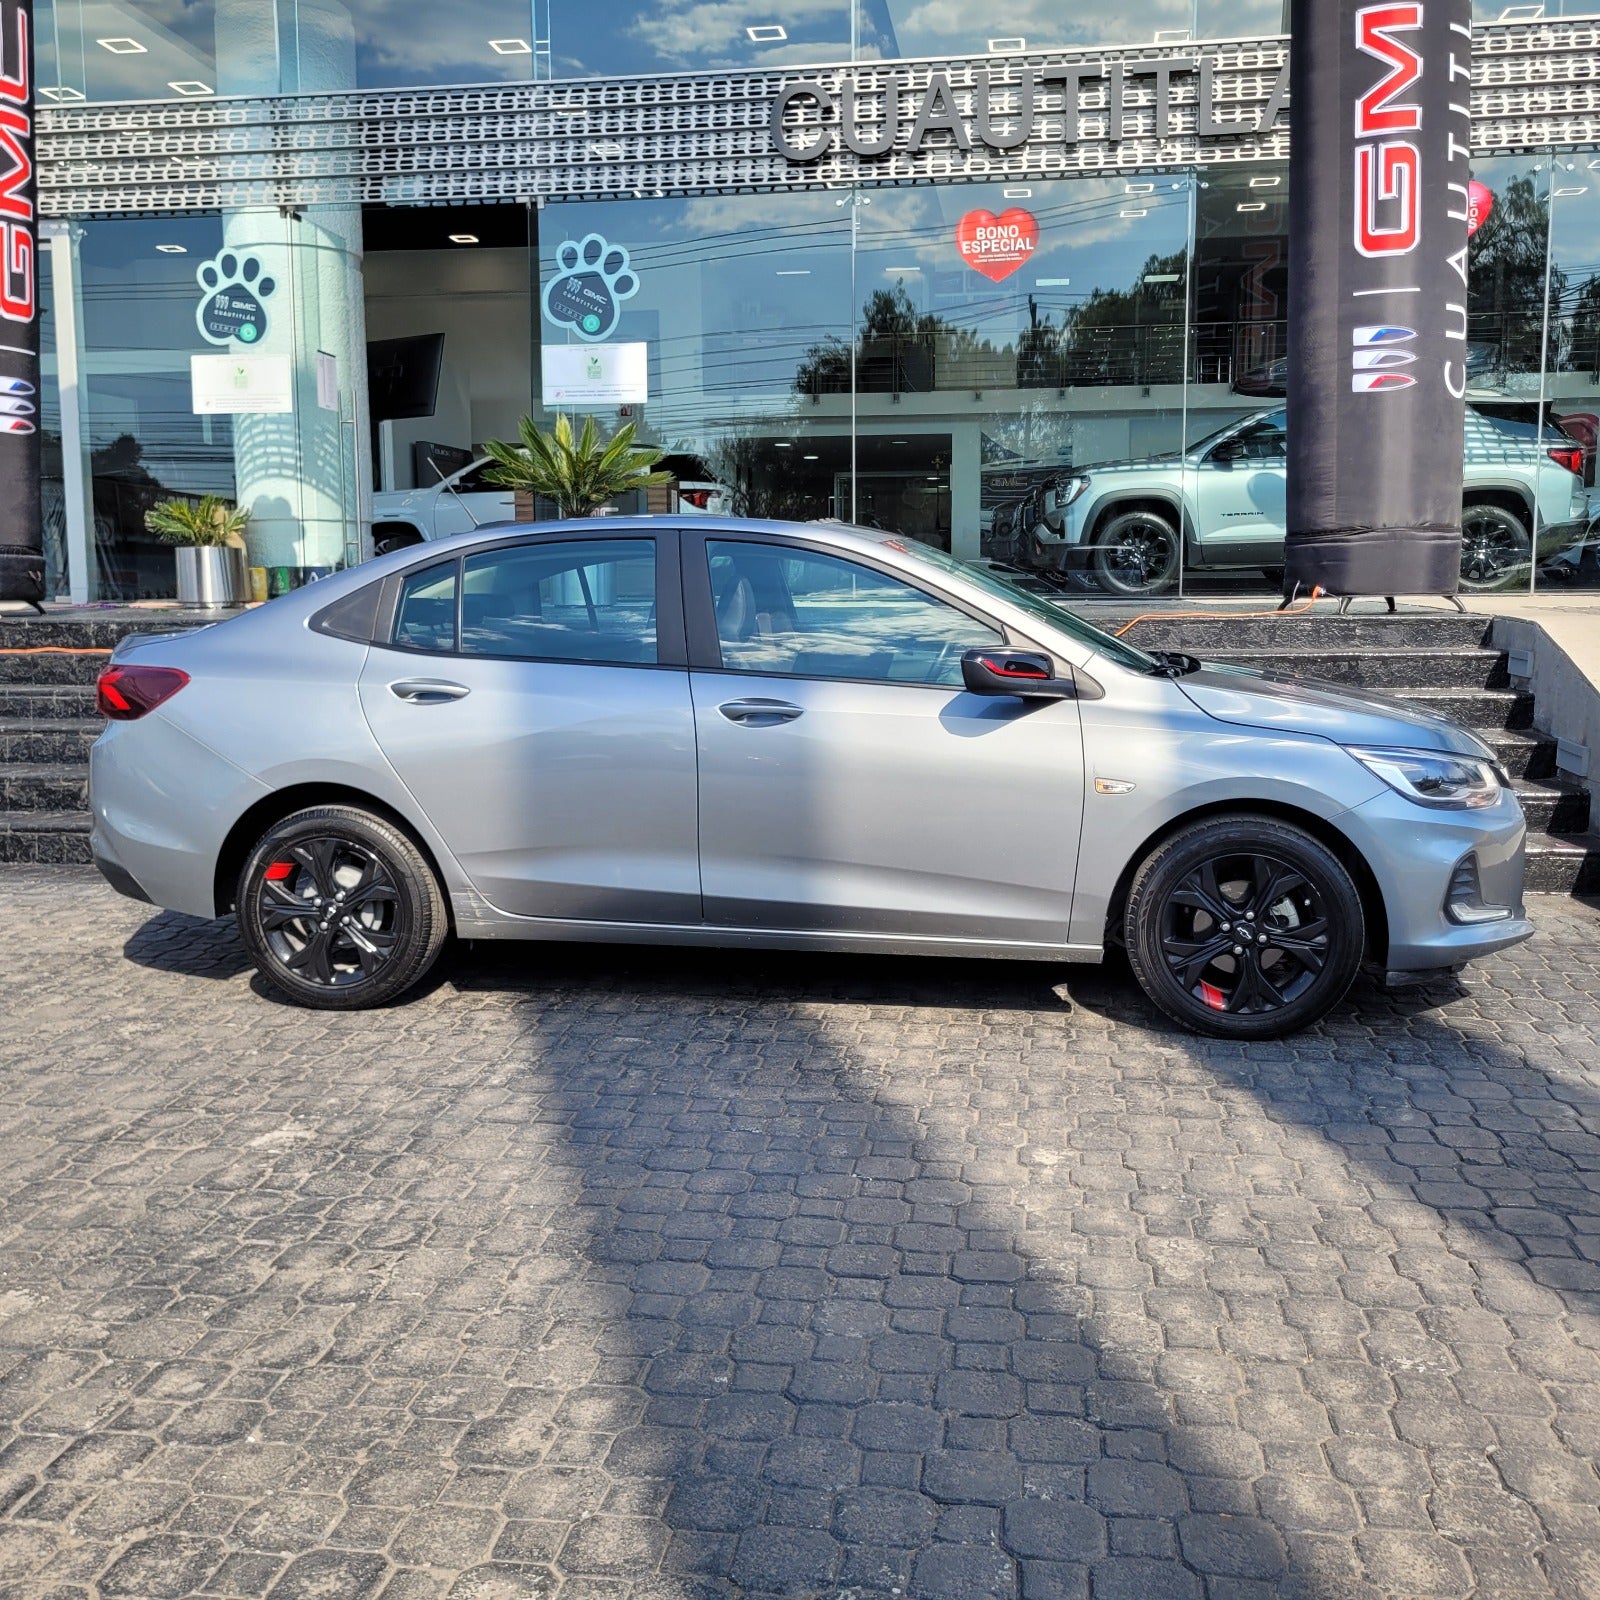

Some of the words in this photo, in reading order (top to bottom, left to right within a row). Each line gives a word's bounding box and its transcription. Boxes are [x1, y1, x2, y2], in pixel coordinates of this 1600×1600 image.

[1444, 1, 1472, 399] CUAUTITL
[976, 224, 1019, 240] BONO
[962, 237, 1035, 254] ESPECIAL
[583, 288, 607, 304] GMC
[231, 300, 256, 311] GMC
